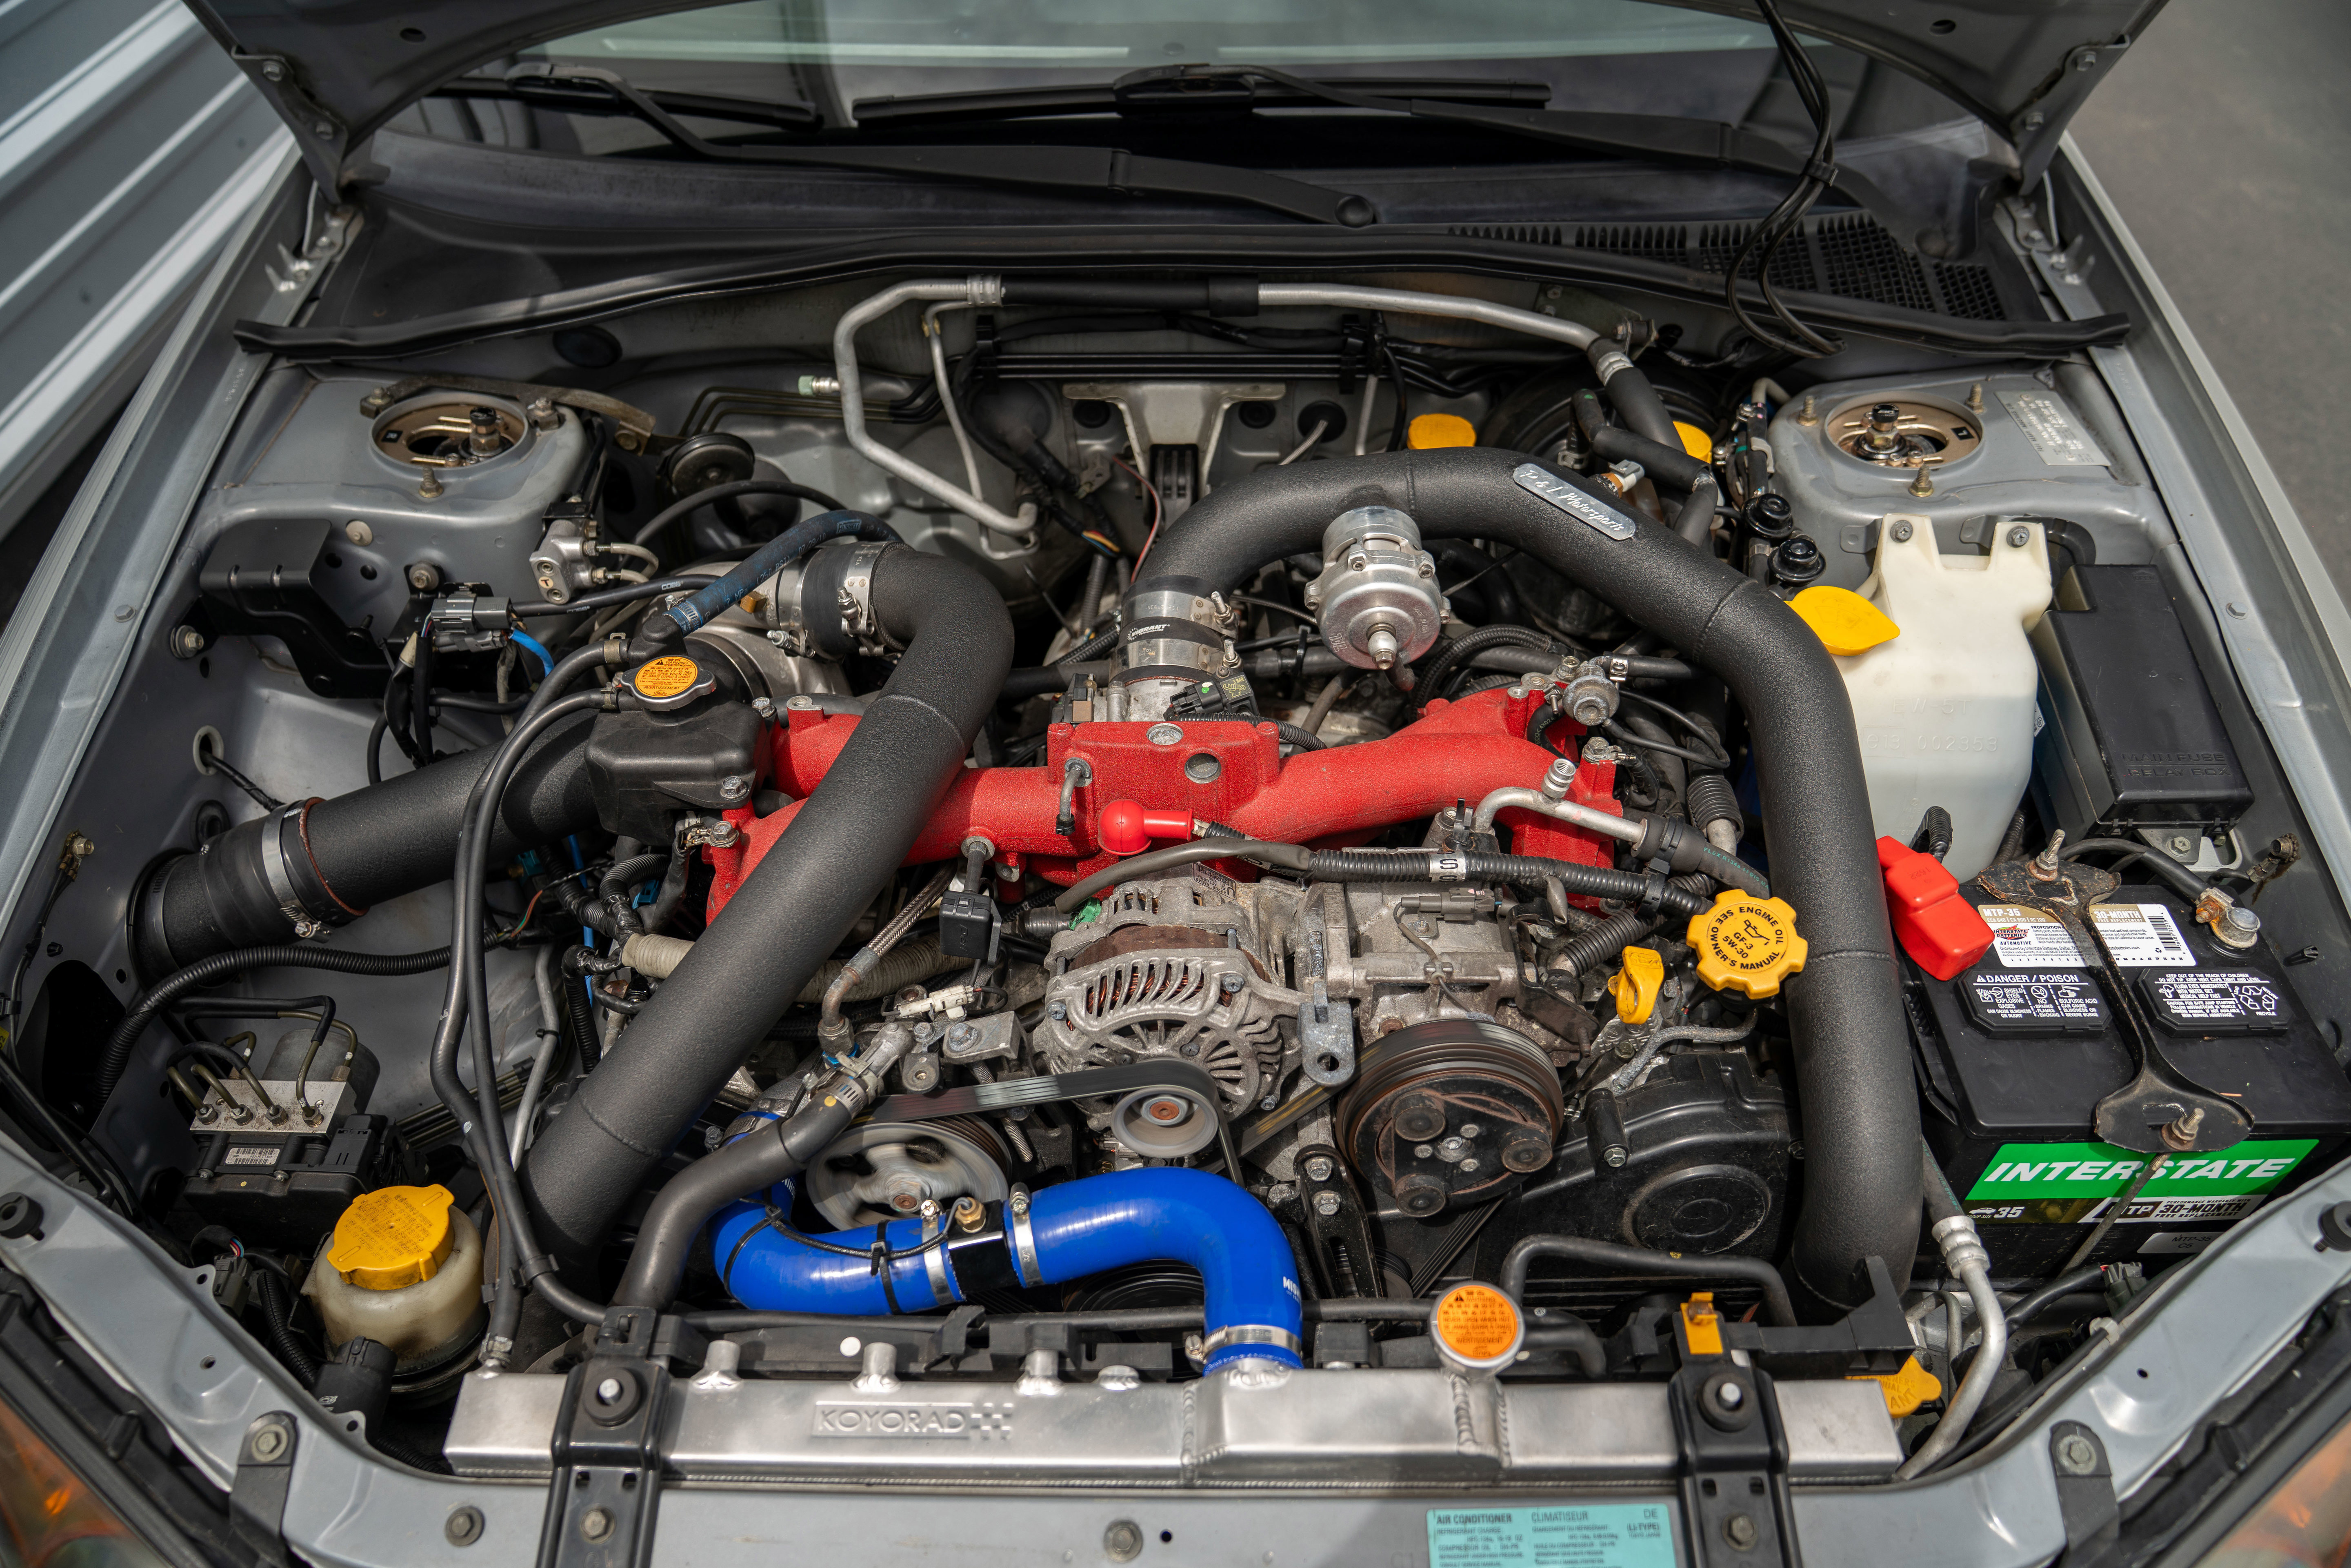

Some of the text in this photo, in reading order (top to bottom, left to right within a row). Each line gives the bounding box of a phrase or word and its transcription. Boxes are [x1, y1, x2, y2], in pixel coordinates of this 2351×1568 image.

[1558, 493, 1624, 530] Motorsports
[757, 568, 773, 585] (250
[776, 556, 790, 571] PSI)
[799, 533, 826, 554] 07/29/10
[1413, 607, 1423, 617] MADE
[1893, 697, 1971, 714] EW-5T
[1867, 734, 1998, 751] e13 002353
[2122, 753, 2173, 762] MAIN
[2128, 767, 2233, 776] RELAY BOX
[1440, 859, 1458, 869] S
[1704, 847, 1721, 857] FLEX
[1722, 856, 1740, 868] R134a
[1196, 878, 1209, 886] AA540
[1213, 886, 1226, 895] 23700
[1982, 908, 2021, 917] MTP-35
[1739, 906, 1784, 944] ENGINE OIL
[1711, 910, 1779, 969] SEE OWNER'S MANUAL
[1722, 935, 1749, 958] 5W-30
[1733, 932, 1753, 950] GF-3
[1994, 1206, 2025, 1218] 35
[2159, 1202, 2246, 1213] 30-MONTH
[818, 1409, 966, 1433] KOYORAD
[1437, 1509, 1658, 1524] AIR CONDITIONER CLIMATISEUR DE
